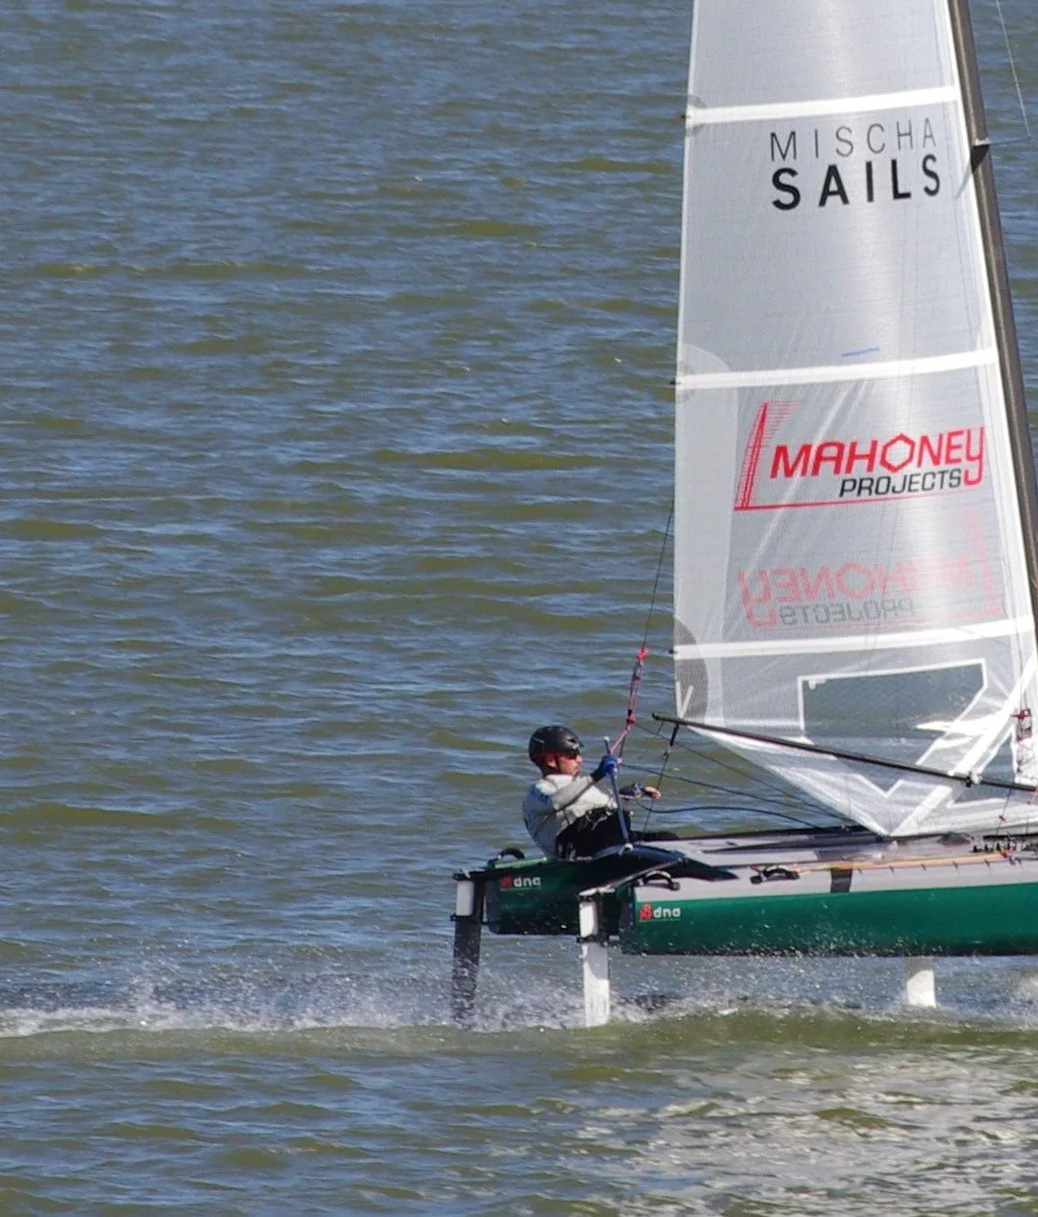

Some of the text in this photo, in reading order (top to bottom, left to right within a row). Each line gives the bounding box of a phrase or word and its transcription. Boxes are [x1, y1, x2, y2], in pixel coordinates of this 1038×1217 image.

[770, 117, 936, 161] MISCHA
[771, 153, 940, 210] SAILS
[769, 425, 985, 487] MAHONEY
[839, 468, 962, 498] PROJECTS
[513, 875, 541, 888] dna
[653, 906, 682, 918] dna
